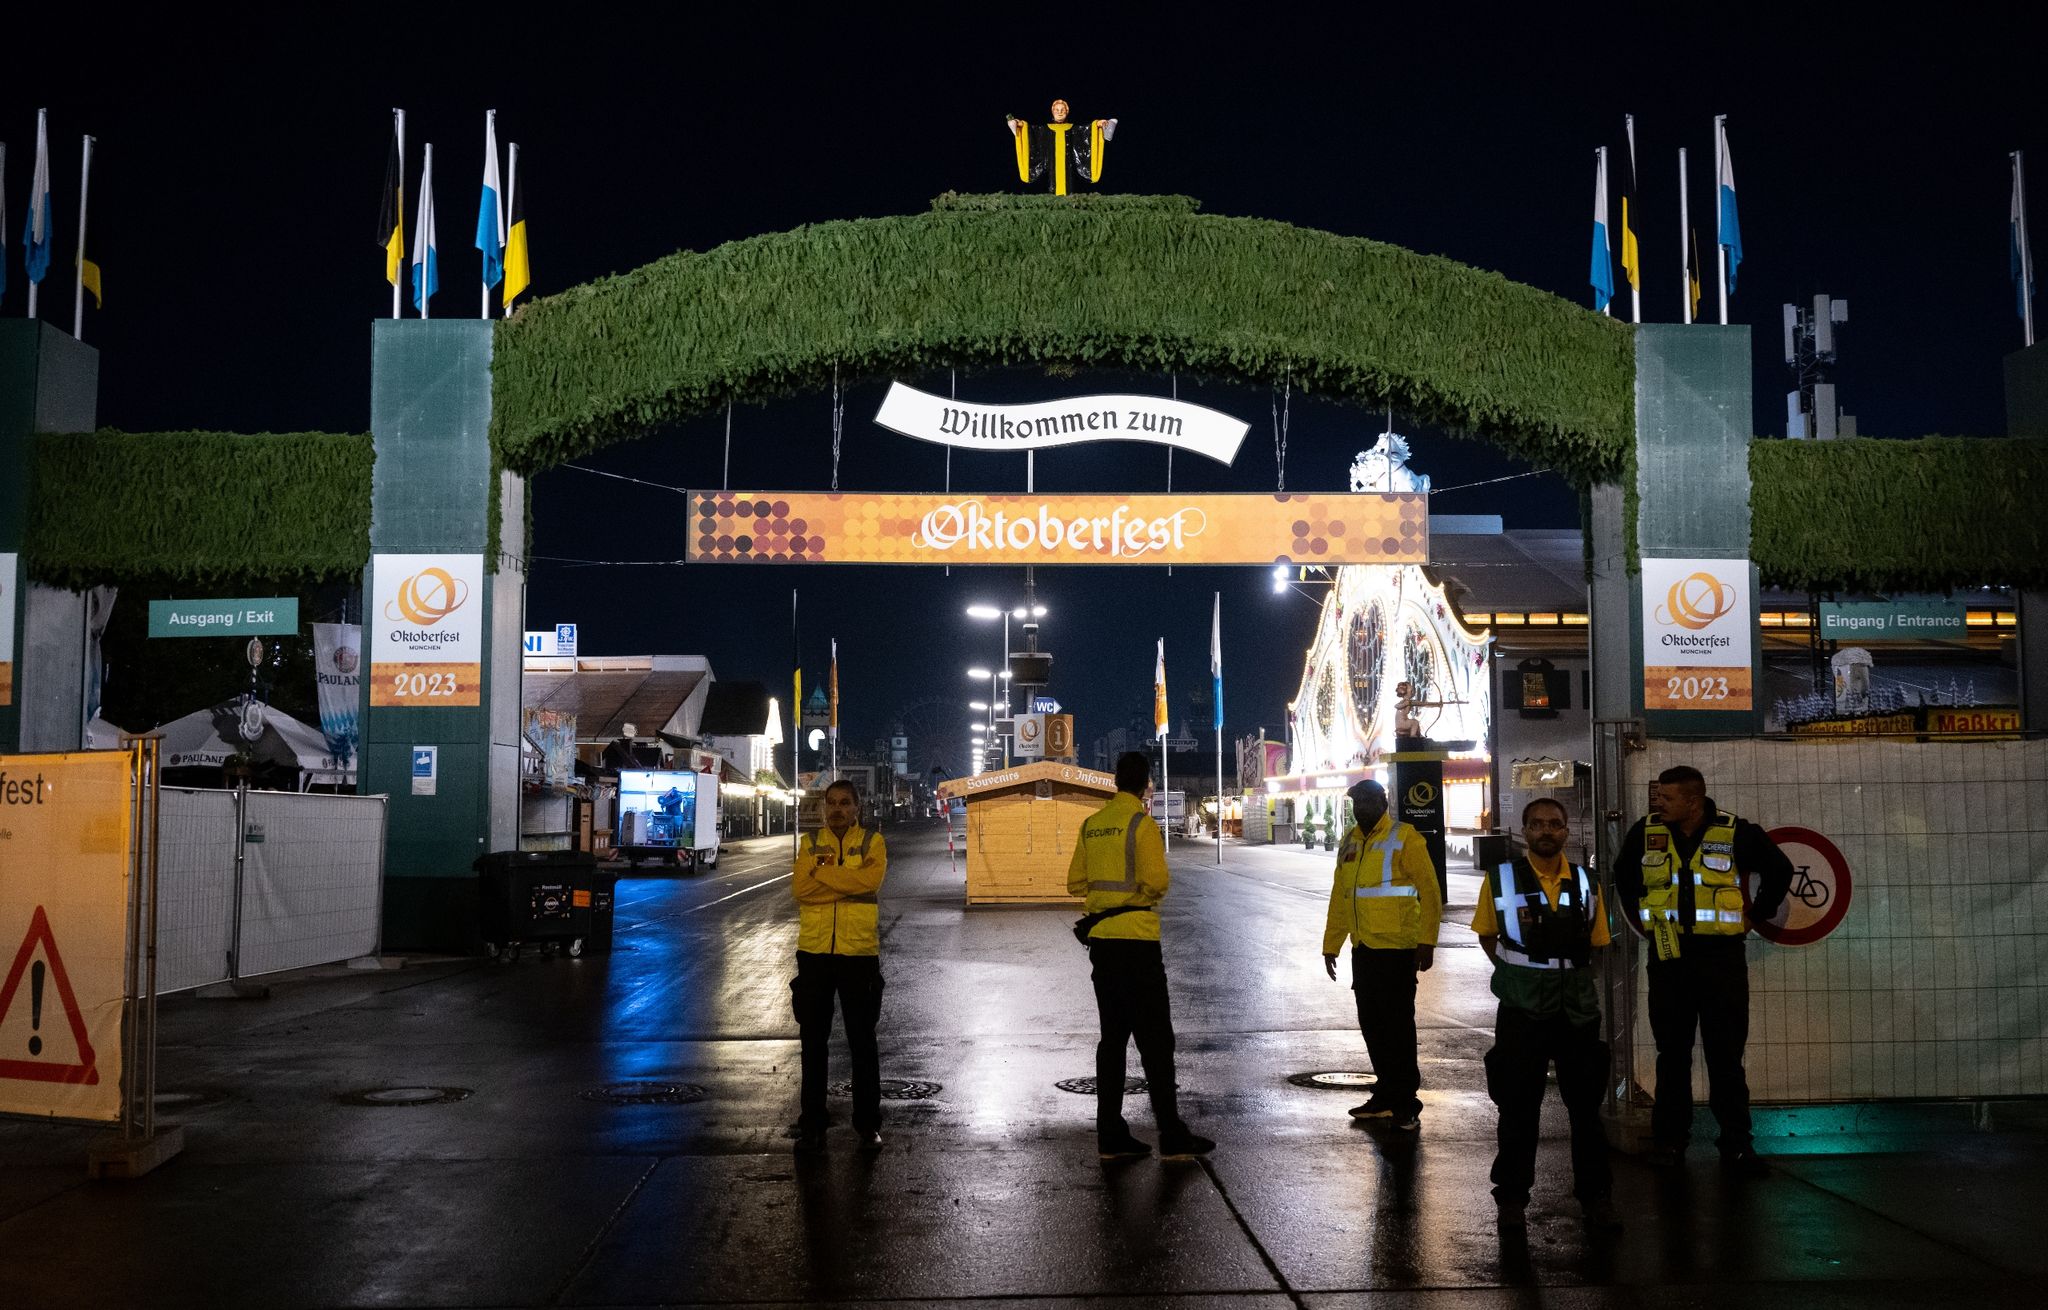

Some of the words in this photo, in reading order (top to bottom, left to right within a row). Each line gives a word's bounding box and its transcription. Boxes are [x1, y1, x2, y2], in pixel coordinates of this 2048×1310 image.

[938, 407, 1118, 440] Willkommen
[1126, 411, 1183, 437] zum
[911, 500, 1207, 558] Oktoberfest
[169, 612, 233, 627] Ausgang
[237, 611, 243, 624] /
[246, 611, 274, 623] Exit
[1826, 615, 1885, 629] Eingang
[1888, 615, 1893, 627] /
[1897, 615, 1961, 627] Entrance
[390, 630, 461, 643] Oktoberfest
[1661, 634, 1730, 648] Oktoberfest
[394, 672, 457, 697] 2023
[1667, 676, 1729, 700] 2023
[1036, 702, 1054, 713] WC
[966, 771, 1020, 790] Souvenirs
[0, 828, 12, 840] lle
[1086, 827, 1123, 838] SECURITY
